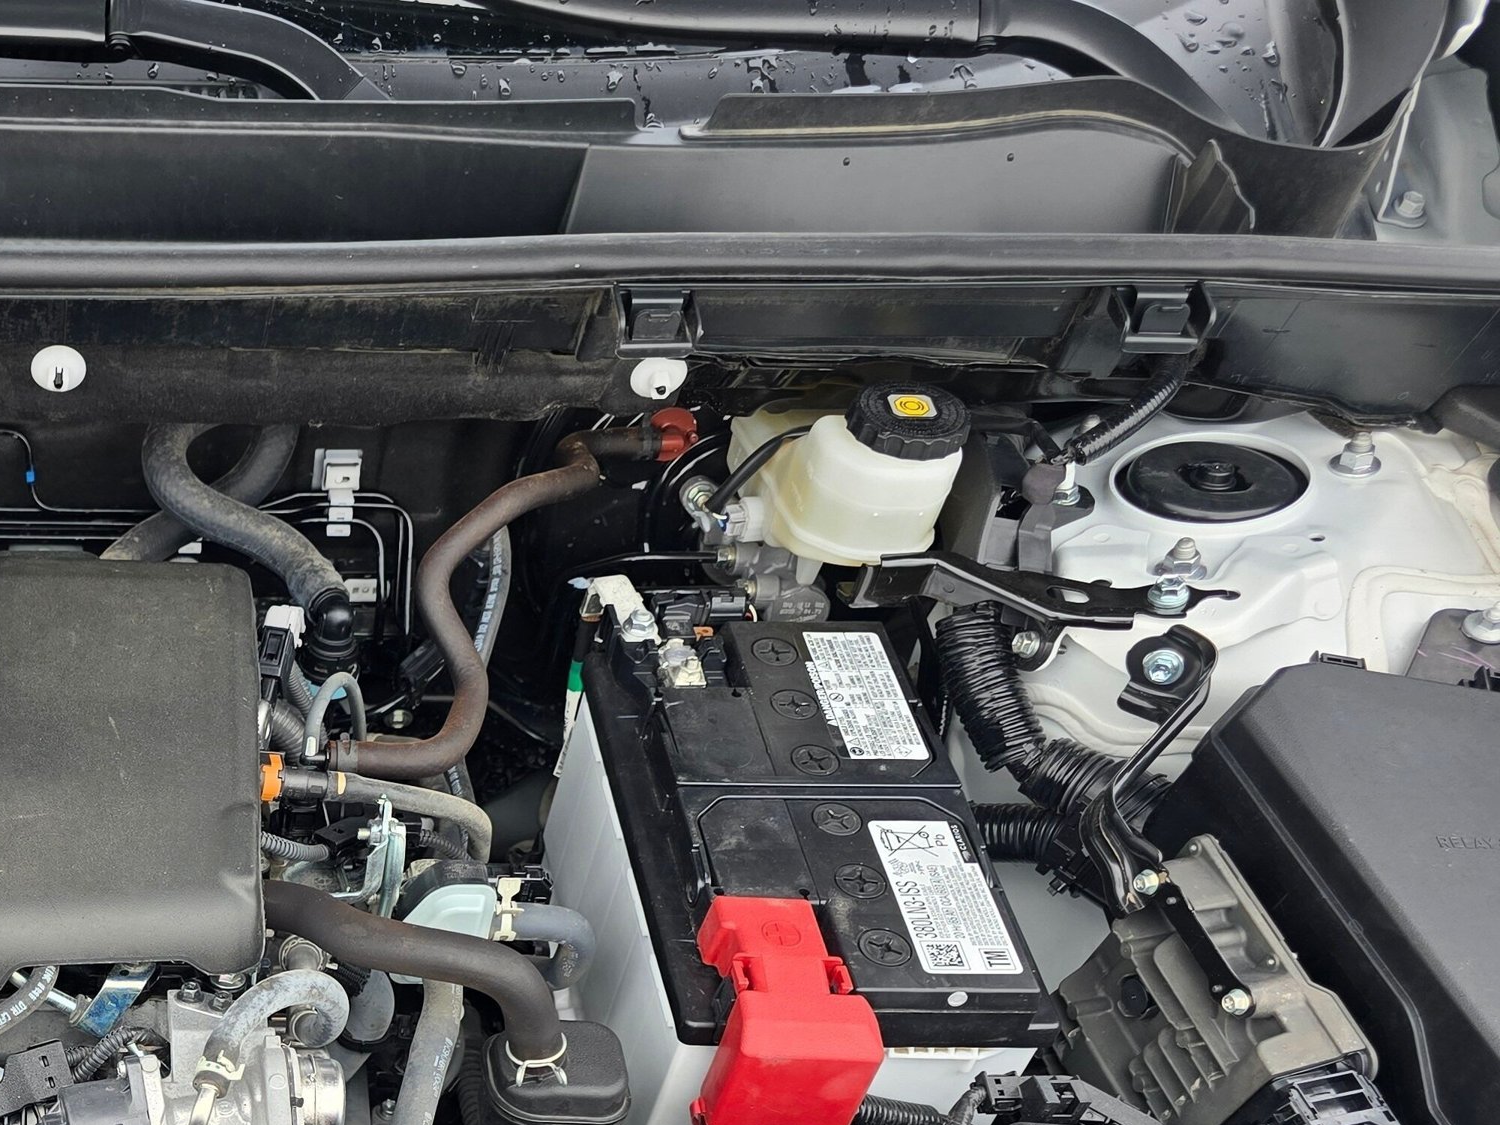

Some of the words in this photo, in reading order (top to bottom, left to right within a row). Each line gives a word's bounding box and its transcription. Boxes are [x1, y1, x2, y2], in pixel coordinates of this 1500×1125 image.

[949, 824, 967, 849] CLARIOS
[894, 881, 937, 938] 380LN3-ISS
[983, 950, 1012, 966] TM
